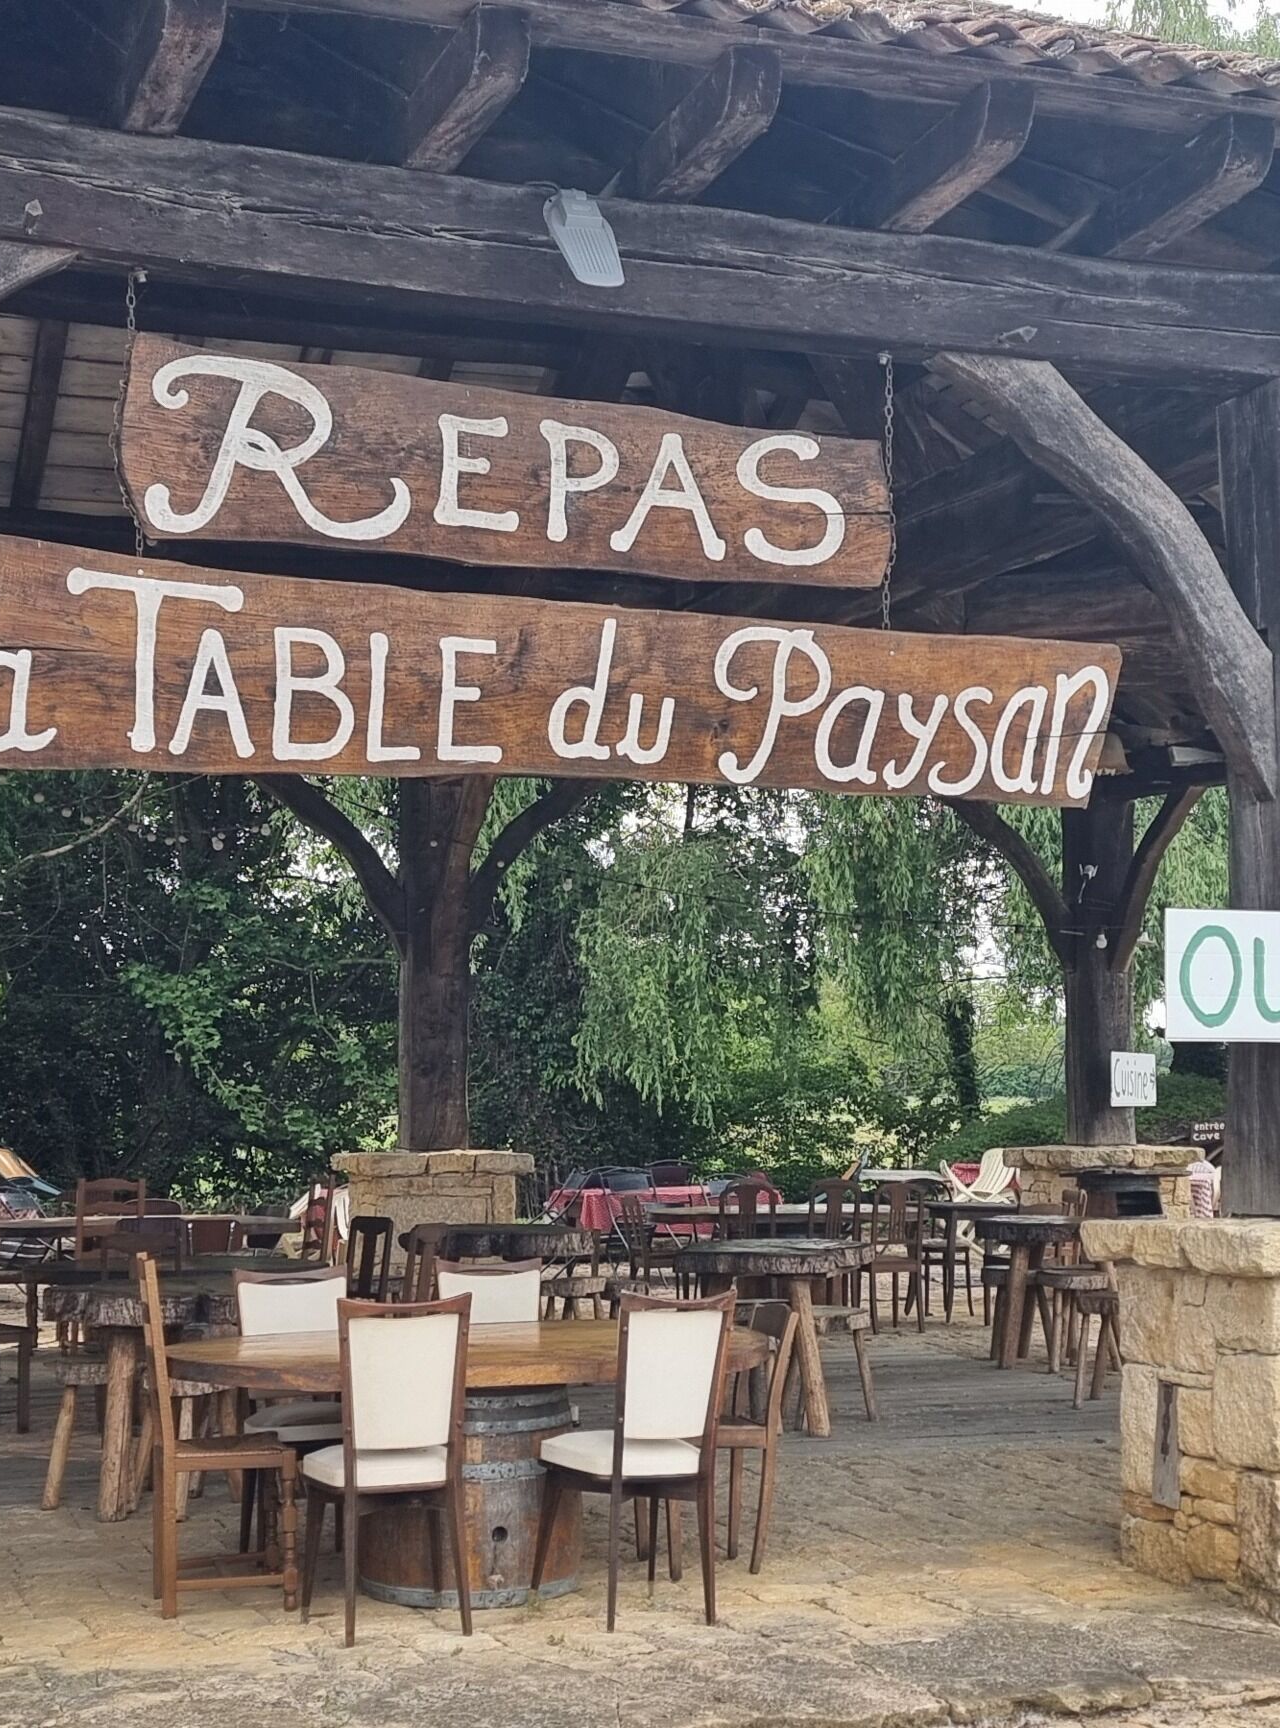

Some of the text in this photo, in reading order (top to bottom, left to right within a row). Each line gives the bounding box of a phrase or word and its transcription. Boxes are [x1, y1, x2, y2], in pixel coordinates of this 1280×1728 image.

[143, 353, 849, 569] REPAS
[66, 565, 503, 764] TABLE
[547, 617, 676, 765] du
[713, 625, 1112, 801] Paysan
[1114, 1058, 1149, 1101] Cuisine
